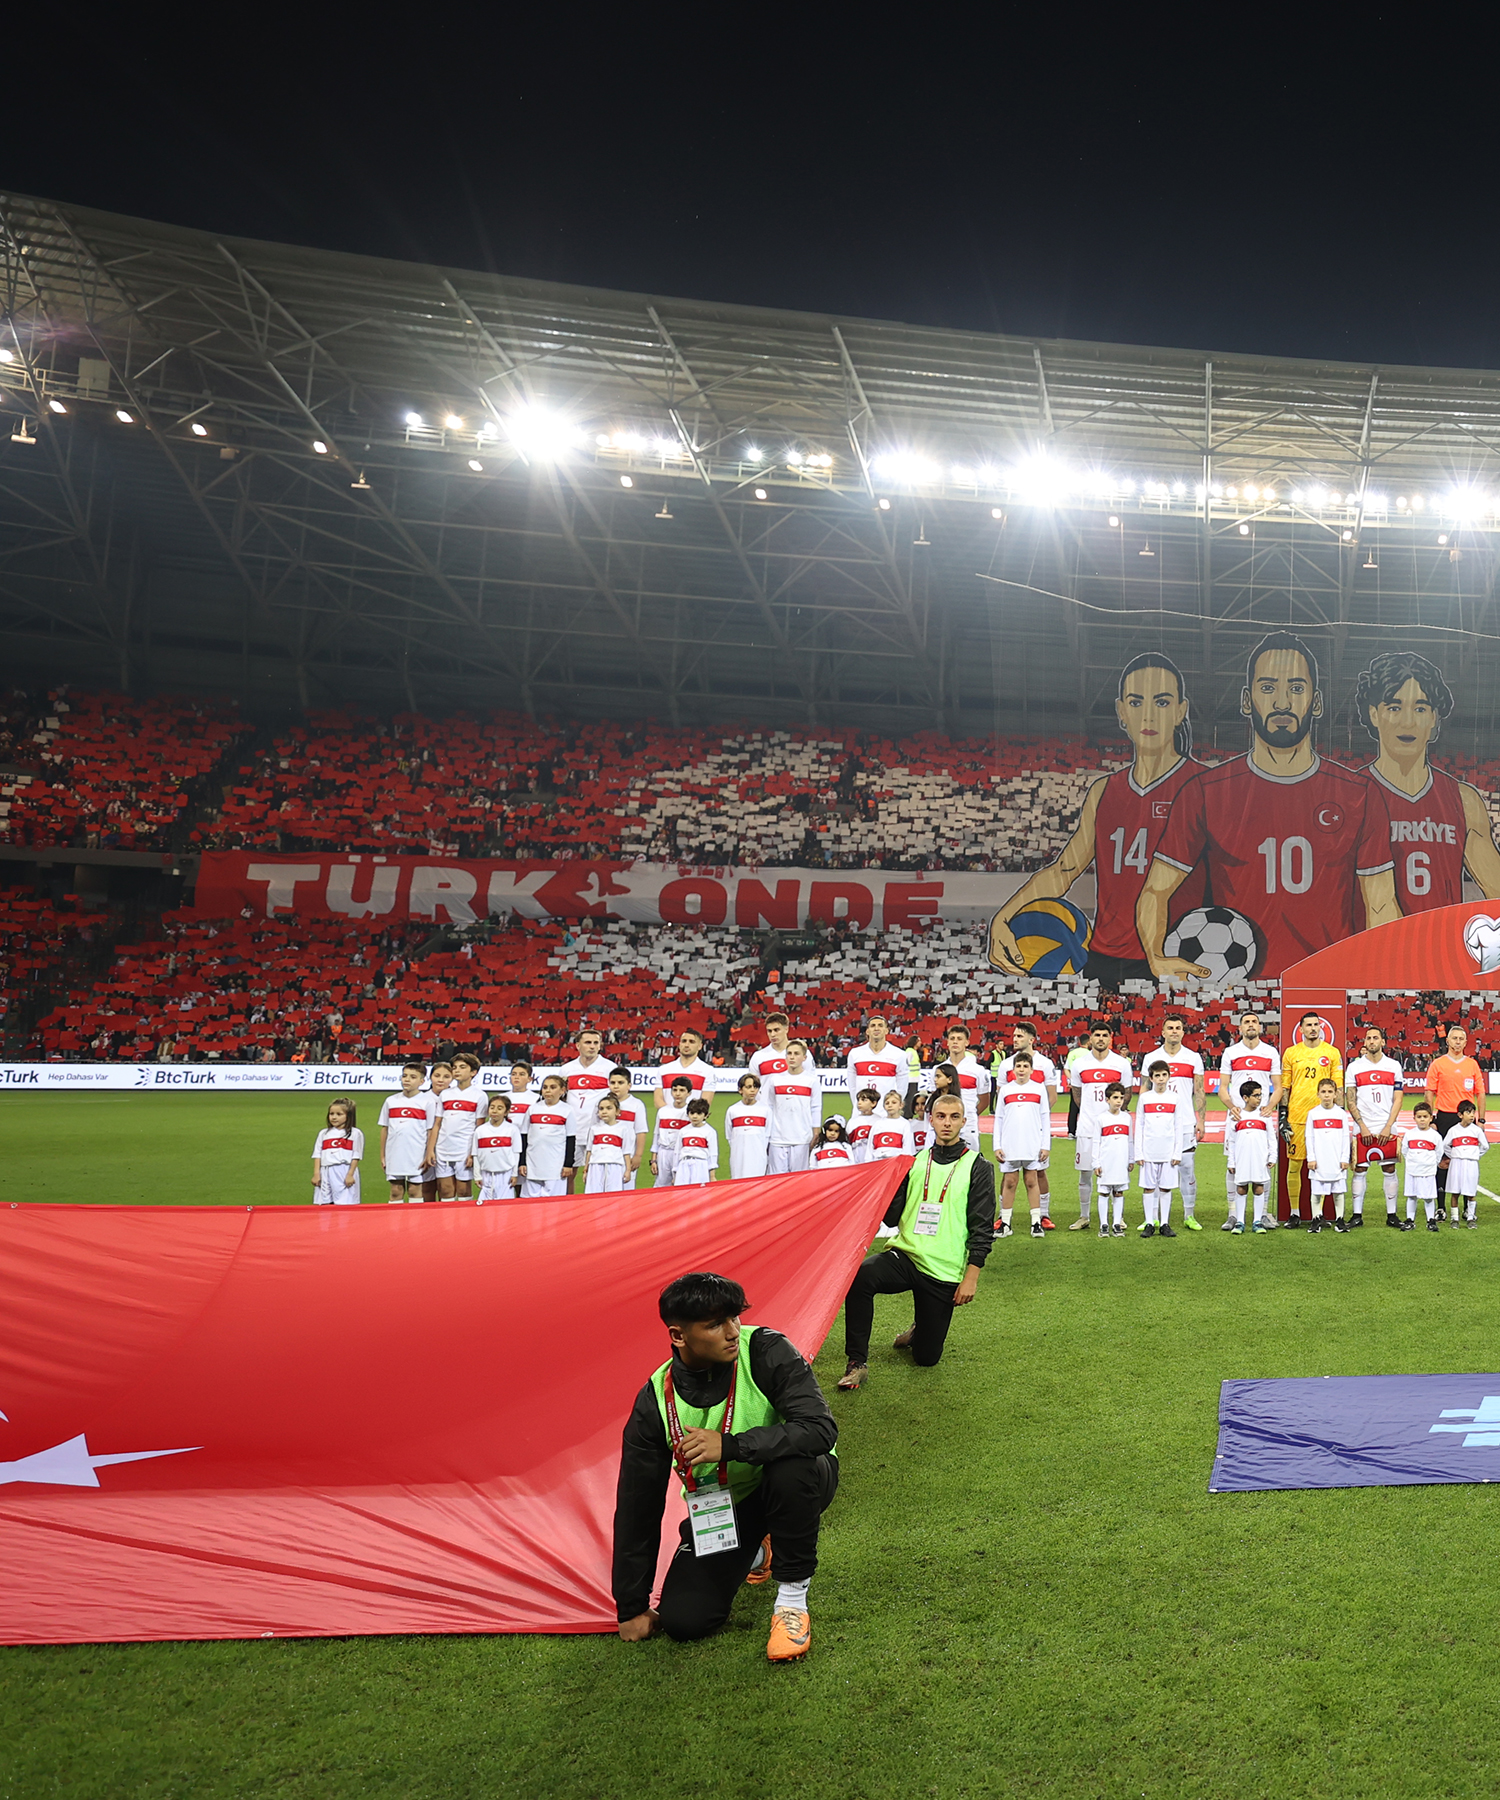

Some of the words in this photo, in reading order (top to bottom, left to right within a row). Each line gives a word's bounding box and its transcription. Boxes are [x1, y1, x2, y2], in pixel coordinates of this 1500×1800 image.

[1390, 816, 1457, 845] RKİYE
[1109, 827, 1148, 875] 14
[1257, 835, 1313, 895] 10
[1406, 851, 1432, 896] 6
[246, 855, 557, 923] TÜRK
[0, 1070, 39, 1083] Turk
[48, 1073, 65, 1082] Hep
[95, 1073, 109, 1081] Var
[155, 1071, 217, 1084] BtcTurk
[224, 1074, 241, 1083] Hep
[314, 1072, 373, 1085] BtcTurk
[382, 1074, 398, 1083] Hep
[1305, 1066, 1317, 1079] 23
[818, 1075, 848, 1087] Turk
[1402, 1078, 1427, 1087] PEAN
[579, 1096, 586, 1109] 7
[1094, 1090, 1104, 1102] 13
[1371, 1091, 1381, 1103] 10
